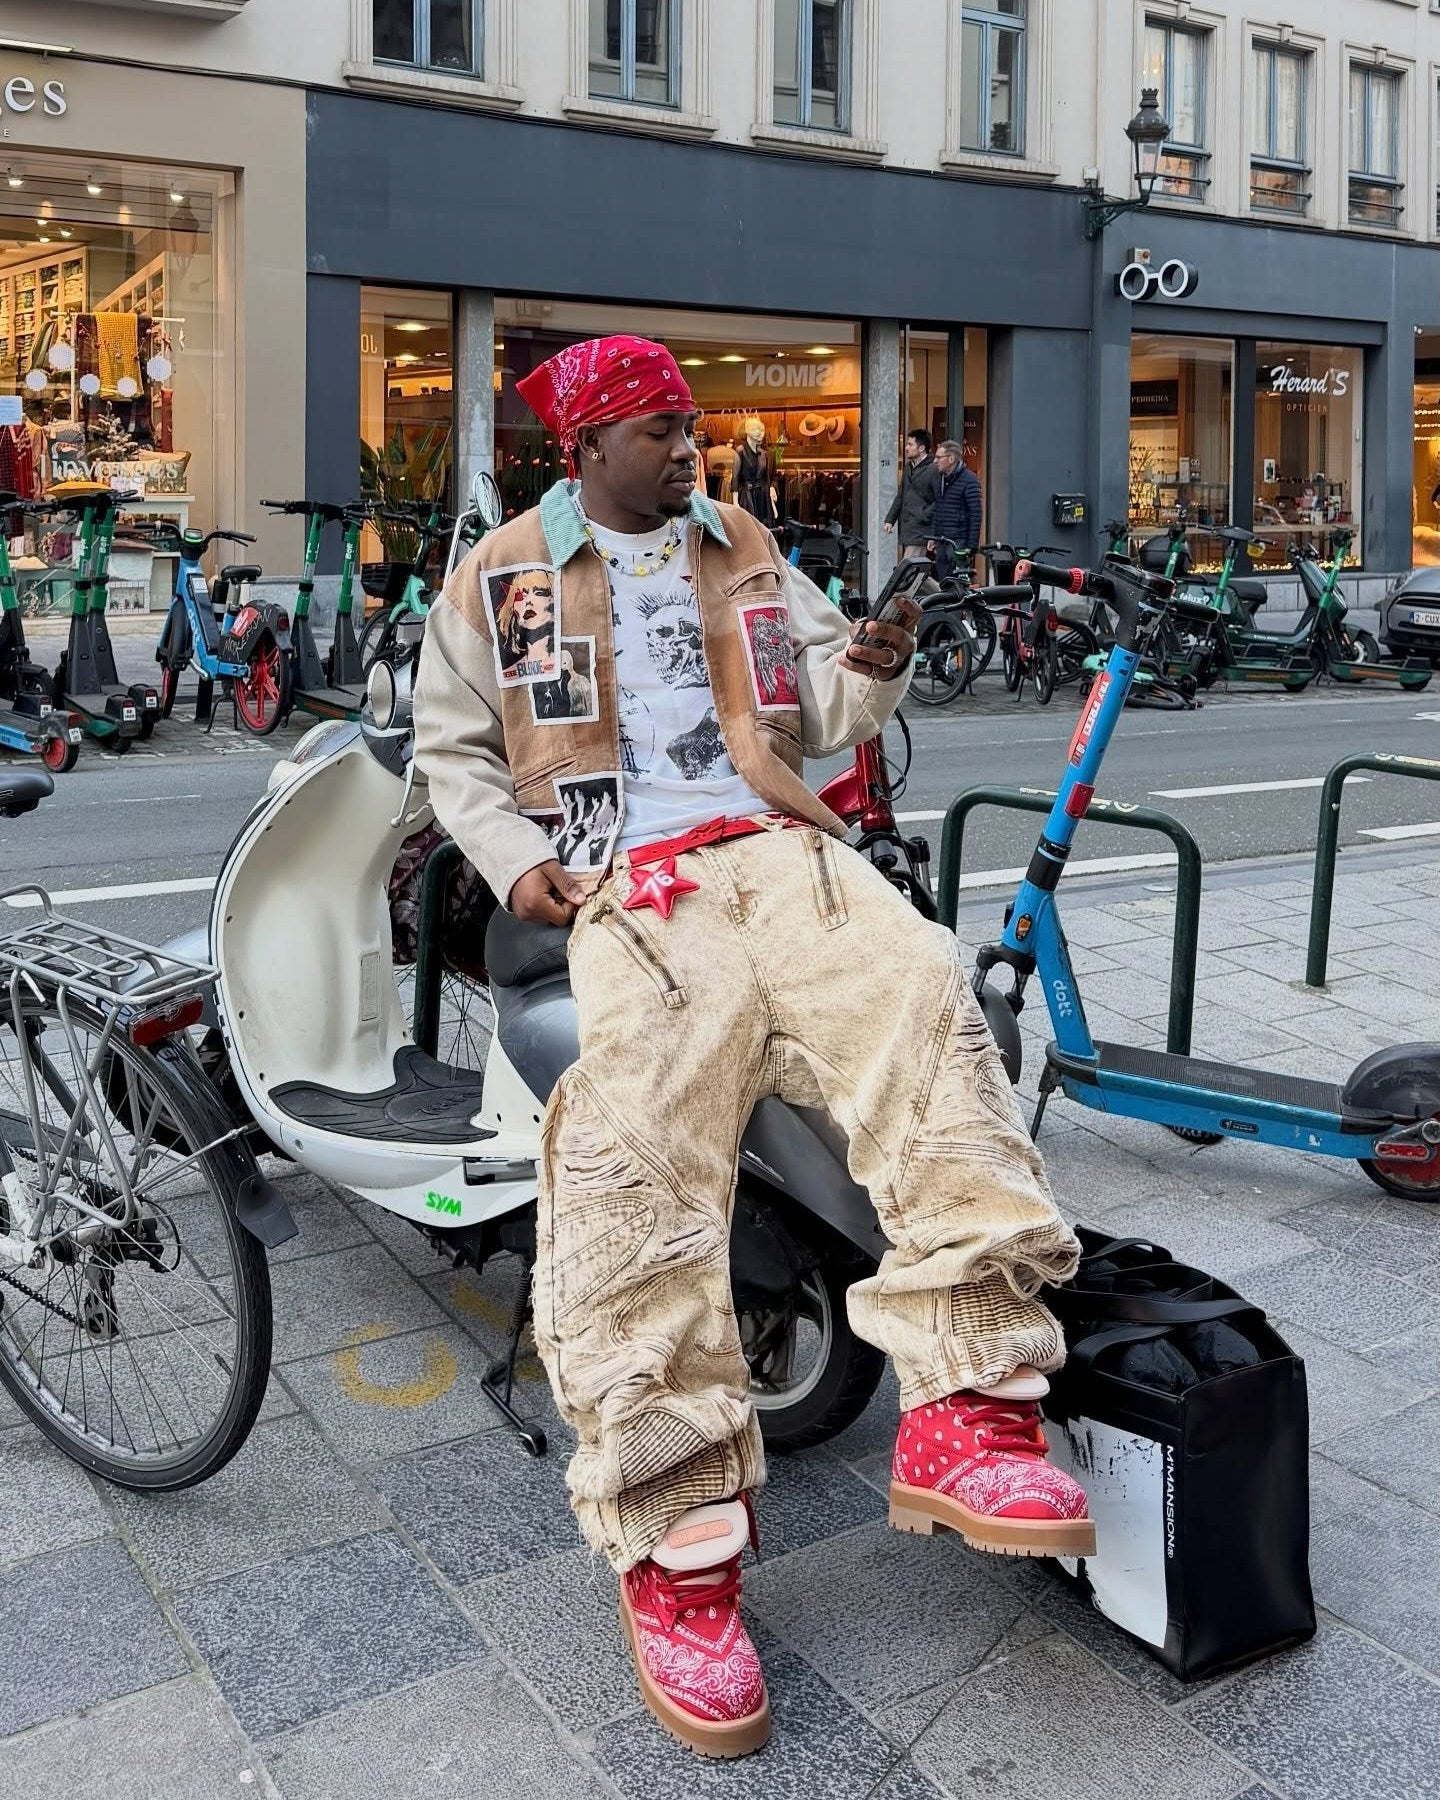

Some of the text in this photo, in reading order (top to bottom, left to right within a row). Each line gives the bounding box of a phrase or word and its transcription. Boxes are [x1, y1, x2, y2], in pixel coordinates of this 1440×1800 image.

[0, 76, 68, 115] es
[1286, 403, 1329, 413] OPTICIEN
[641, 869, 677, 898] 76
[425, 1191, 463, 1217] SYM
